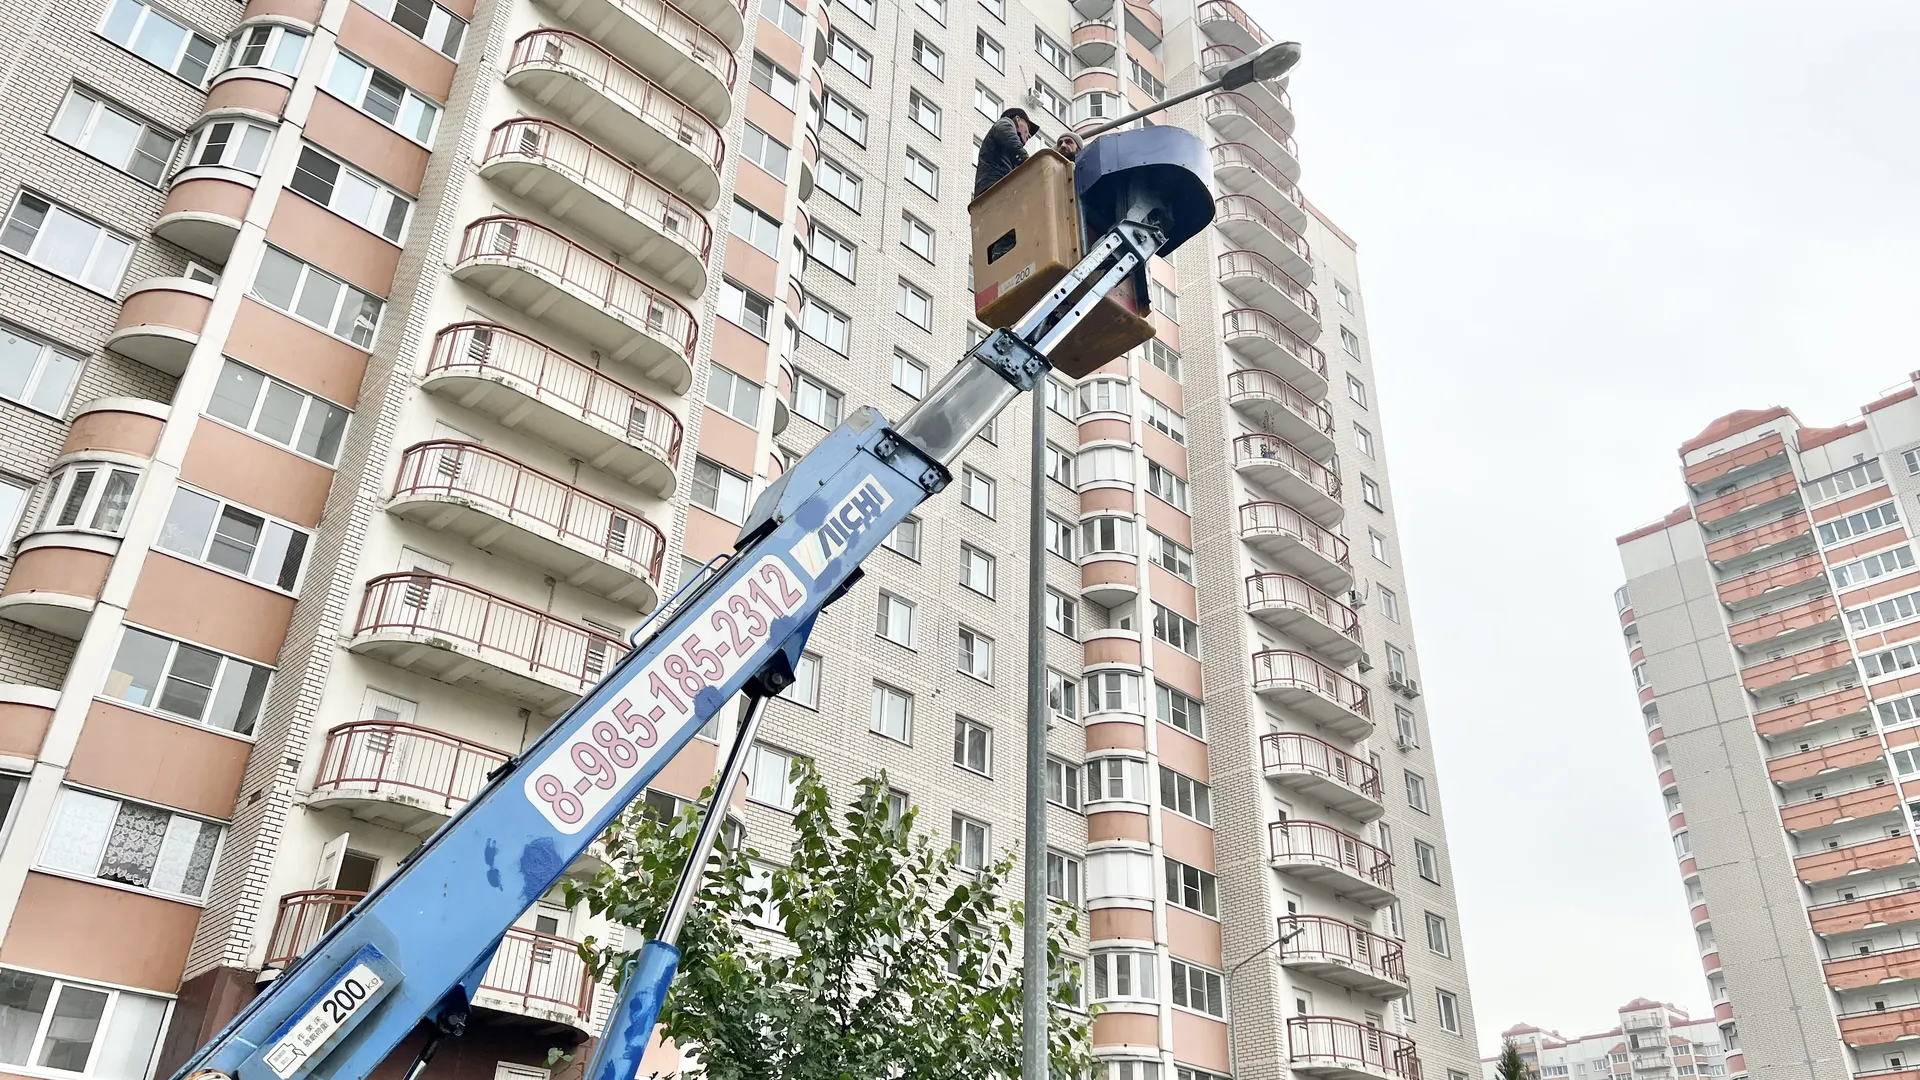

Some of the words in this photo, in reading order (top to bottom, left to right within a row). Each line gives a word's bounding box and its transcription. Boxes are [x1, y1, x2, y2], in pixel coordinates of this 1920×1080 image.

[1015, 267, 1030, 284] 200
[818, 482, 885, 559] AICHI
[535, 563, 803, 824] 8-985-185-2312
[322, 978, 366, 1024] 200
[366, 977, 379, 990] kg
